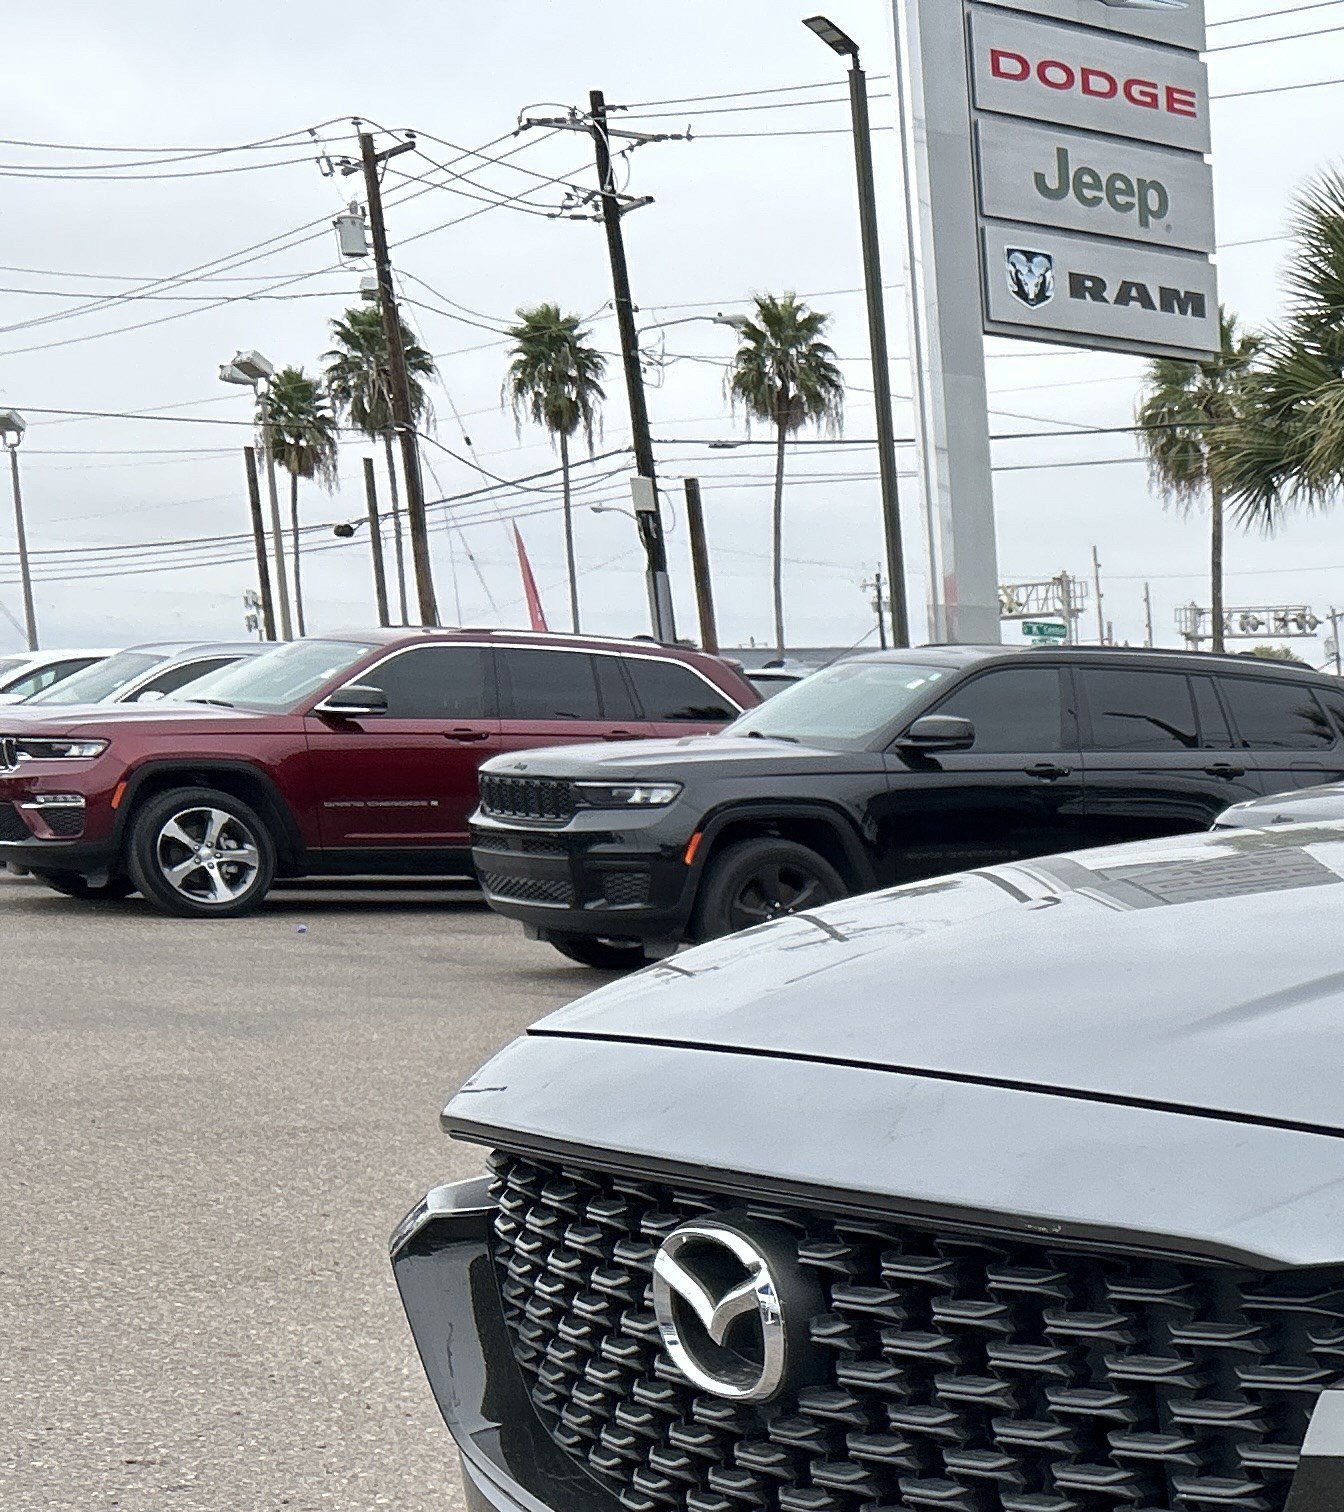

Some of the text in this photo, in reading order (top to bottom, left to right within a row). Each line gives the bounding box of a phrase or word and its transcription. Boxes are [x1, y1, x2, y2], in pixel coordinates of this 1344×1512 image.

[989, 48, 1196, 118] DODGE
[1033, 146, 1169, 228] Jeep
[1067, 271, 1207, 319] RAM
